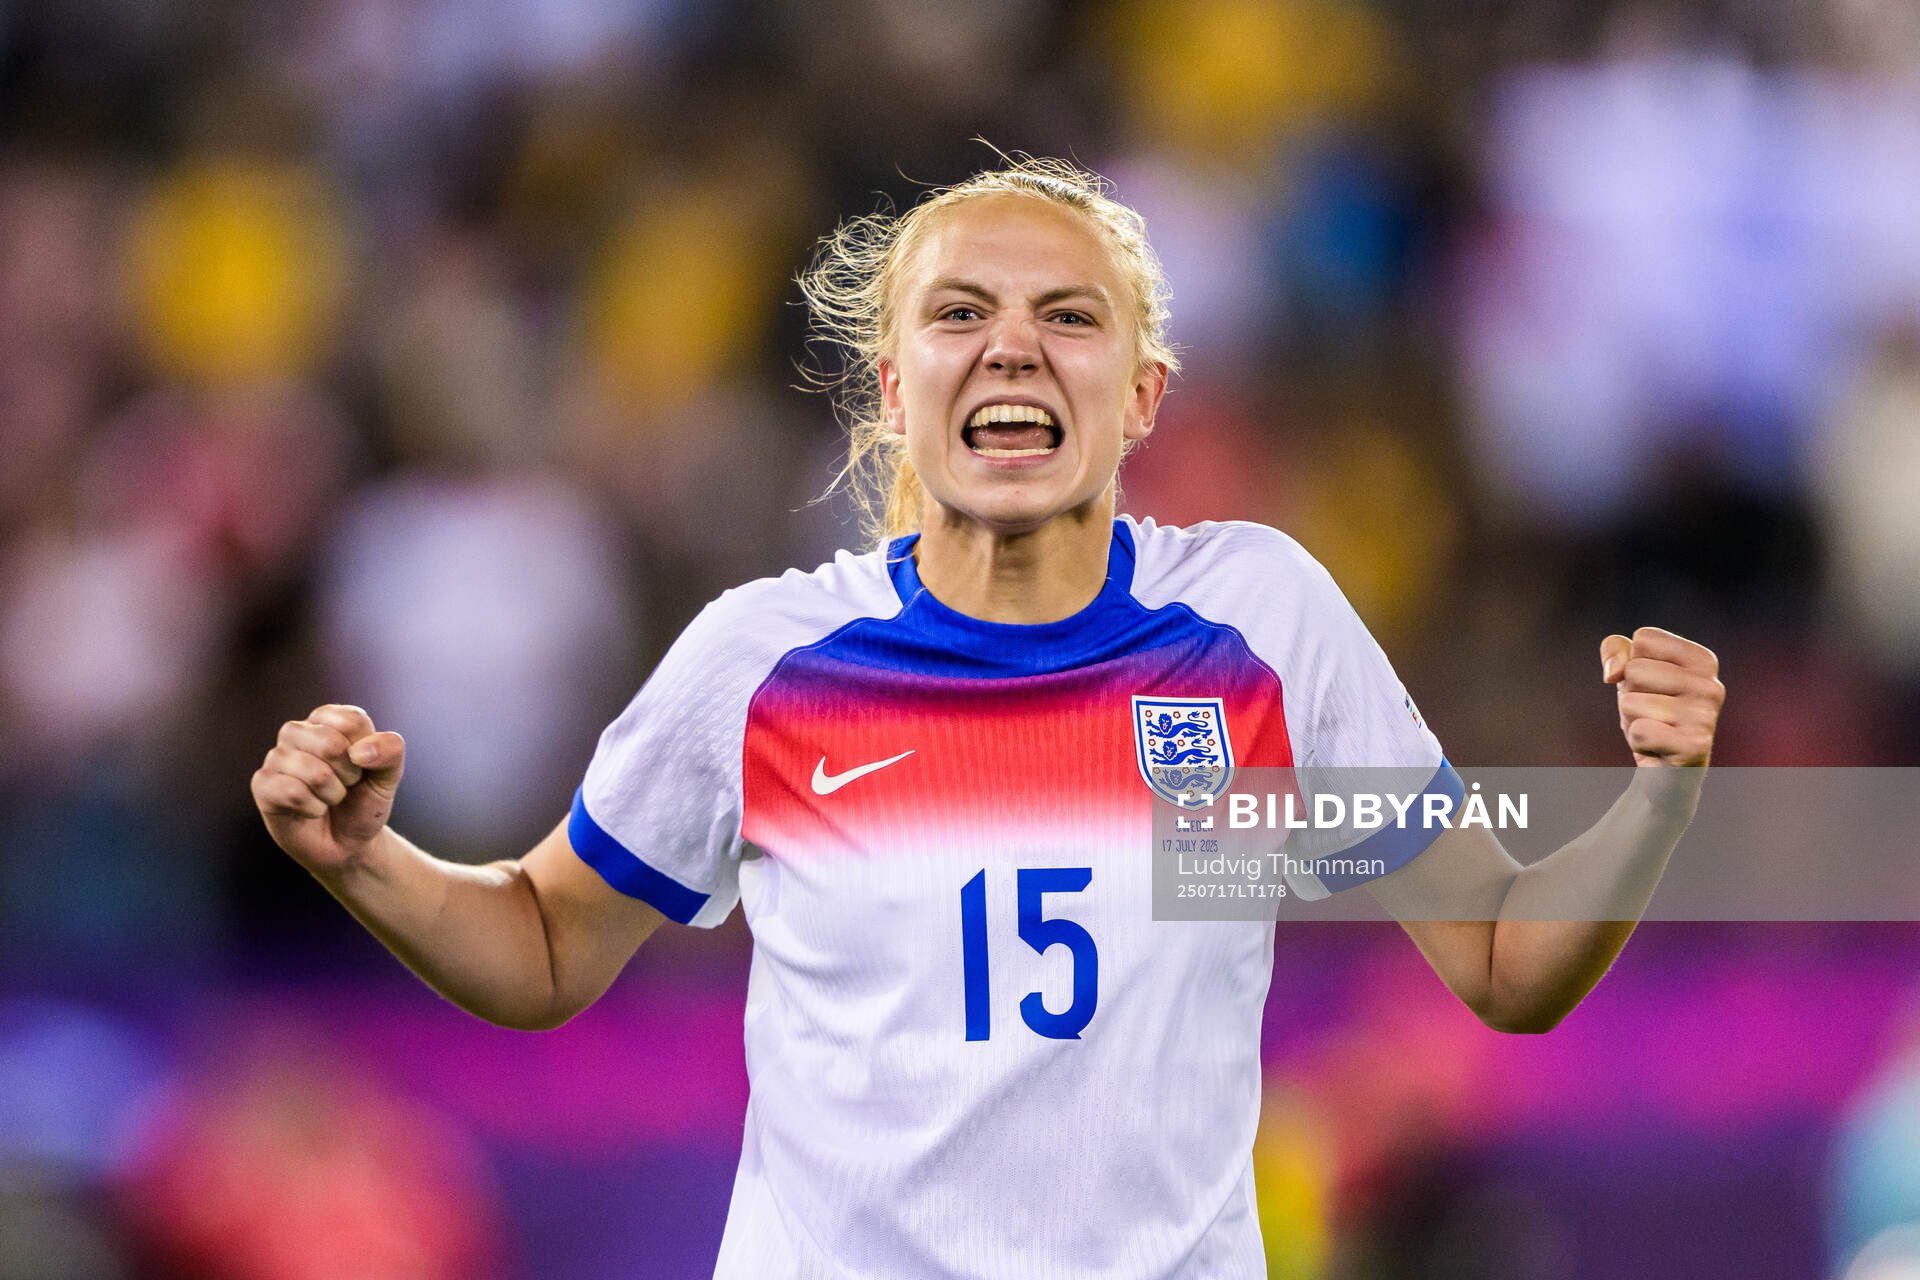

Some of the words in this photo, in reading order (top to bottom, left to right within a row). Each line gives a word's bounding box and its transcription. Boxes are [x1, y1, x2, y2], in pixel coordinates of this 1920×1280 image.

[1162, 839, 1172, 853] 17
[1175, 839, 1197, 853] JULY
[1200, 839, 1219, 853] 2025
[960, 867, 1099, 1042] 15
